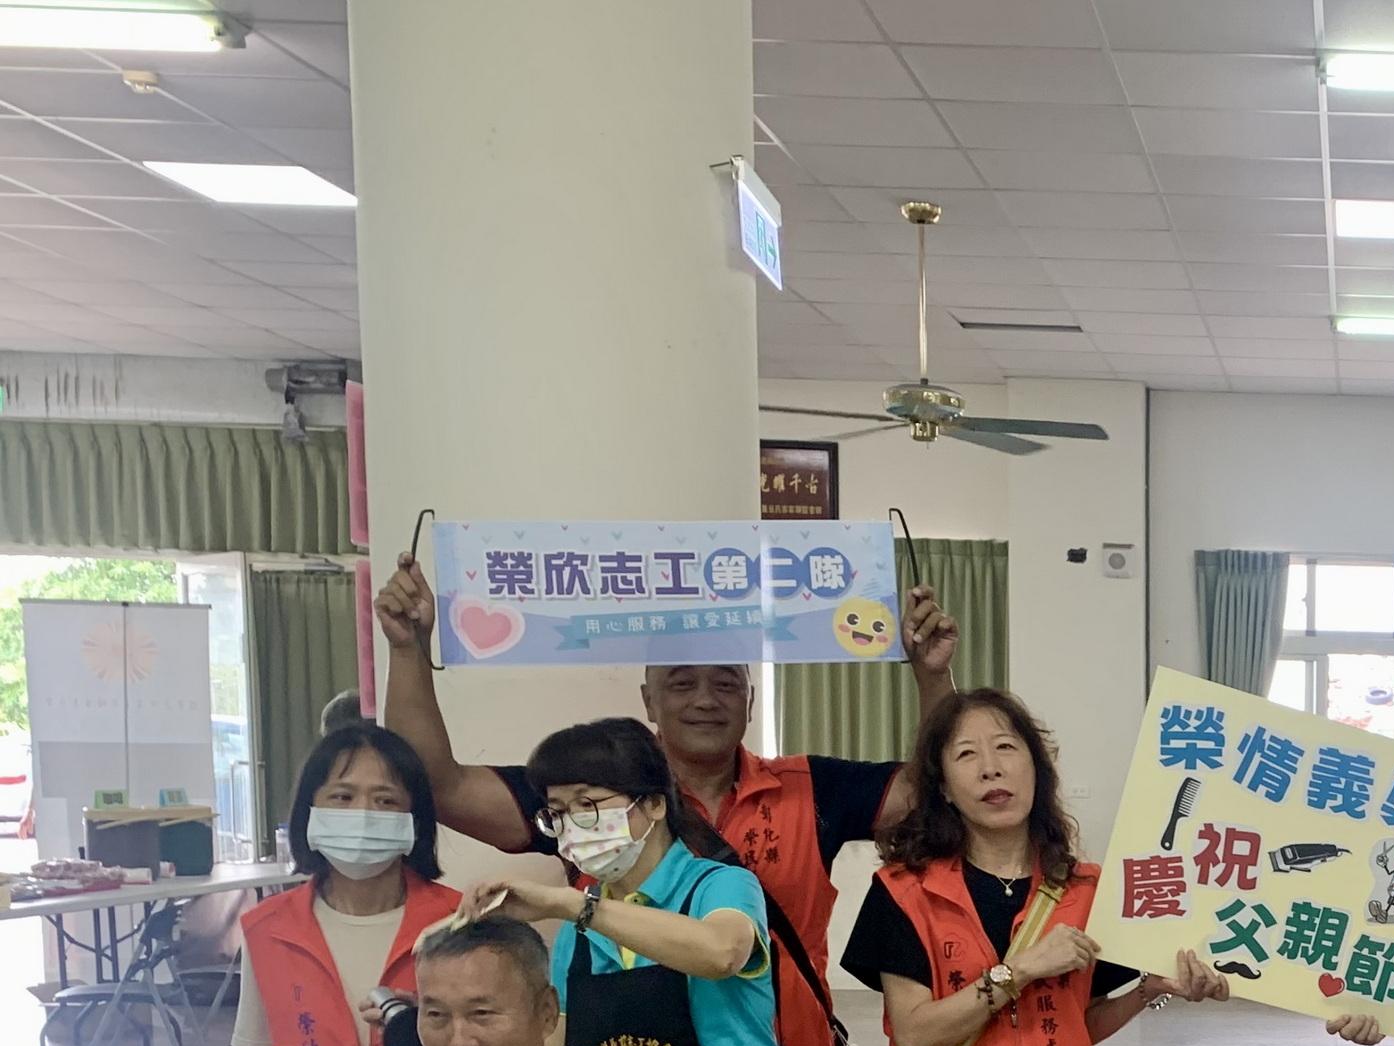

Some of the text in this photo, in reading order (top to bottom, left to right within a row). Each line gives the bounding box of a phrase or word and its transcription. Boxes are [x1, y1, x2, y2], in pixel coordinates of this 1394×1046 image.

[486, 550, 847, 597] 榮欣志工第二隊
[585, 615, 666, 634] 用心服務
[1121, 822, 1262, 920] 慶祝
